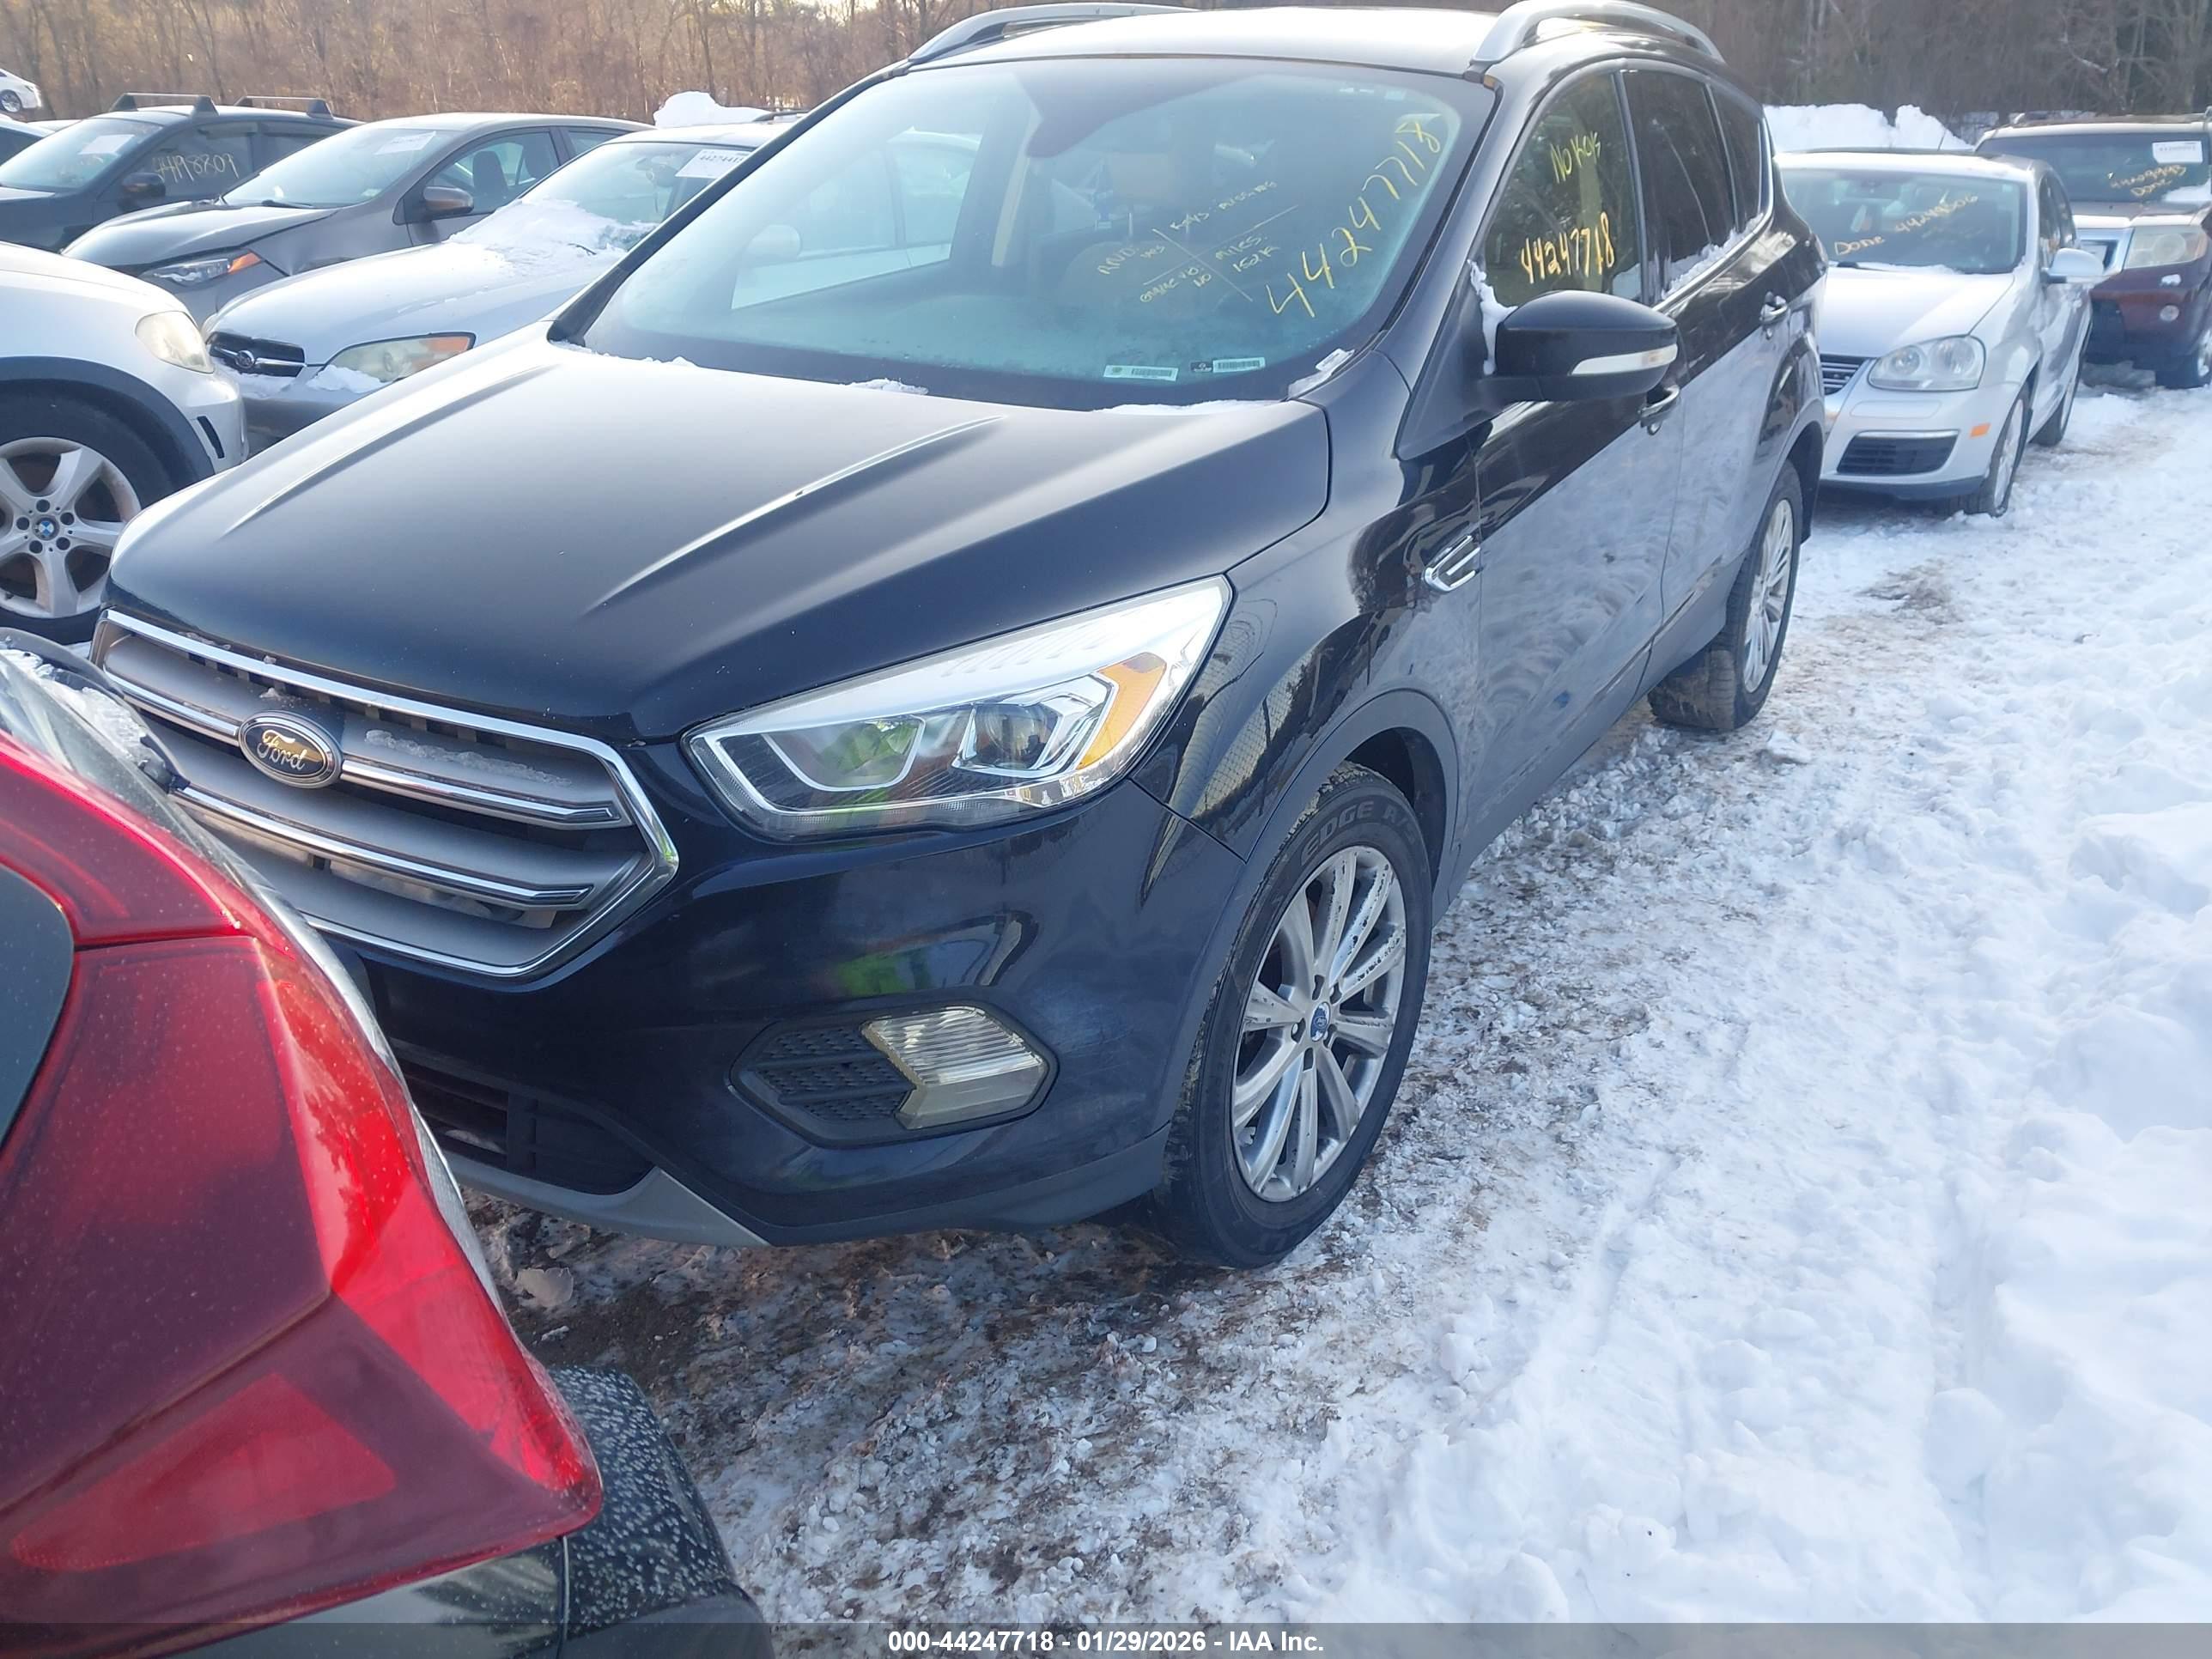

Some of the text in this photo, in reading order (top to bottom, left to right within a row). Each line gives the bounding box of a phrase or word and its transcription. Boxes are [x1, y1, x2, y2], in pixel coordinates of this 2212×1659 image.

[1266, 118, 1441, 318] 44247718
[1520, 211, 1615, 284] 44247718
[257, 729, 306, 771] Ford
[1300, 800, 1374, 867] EDGE
